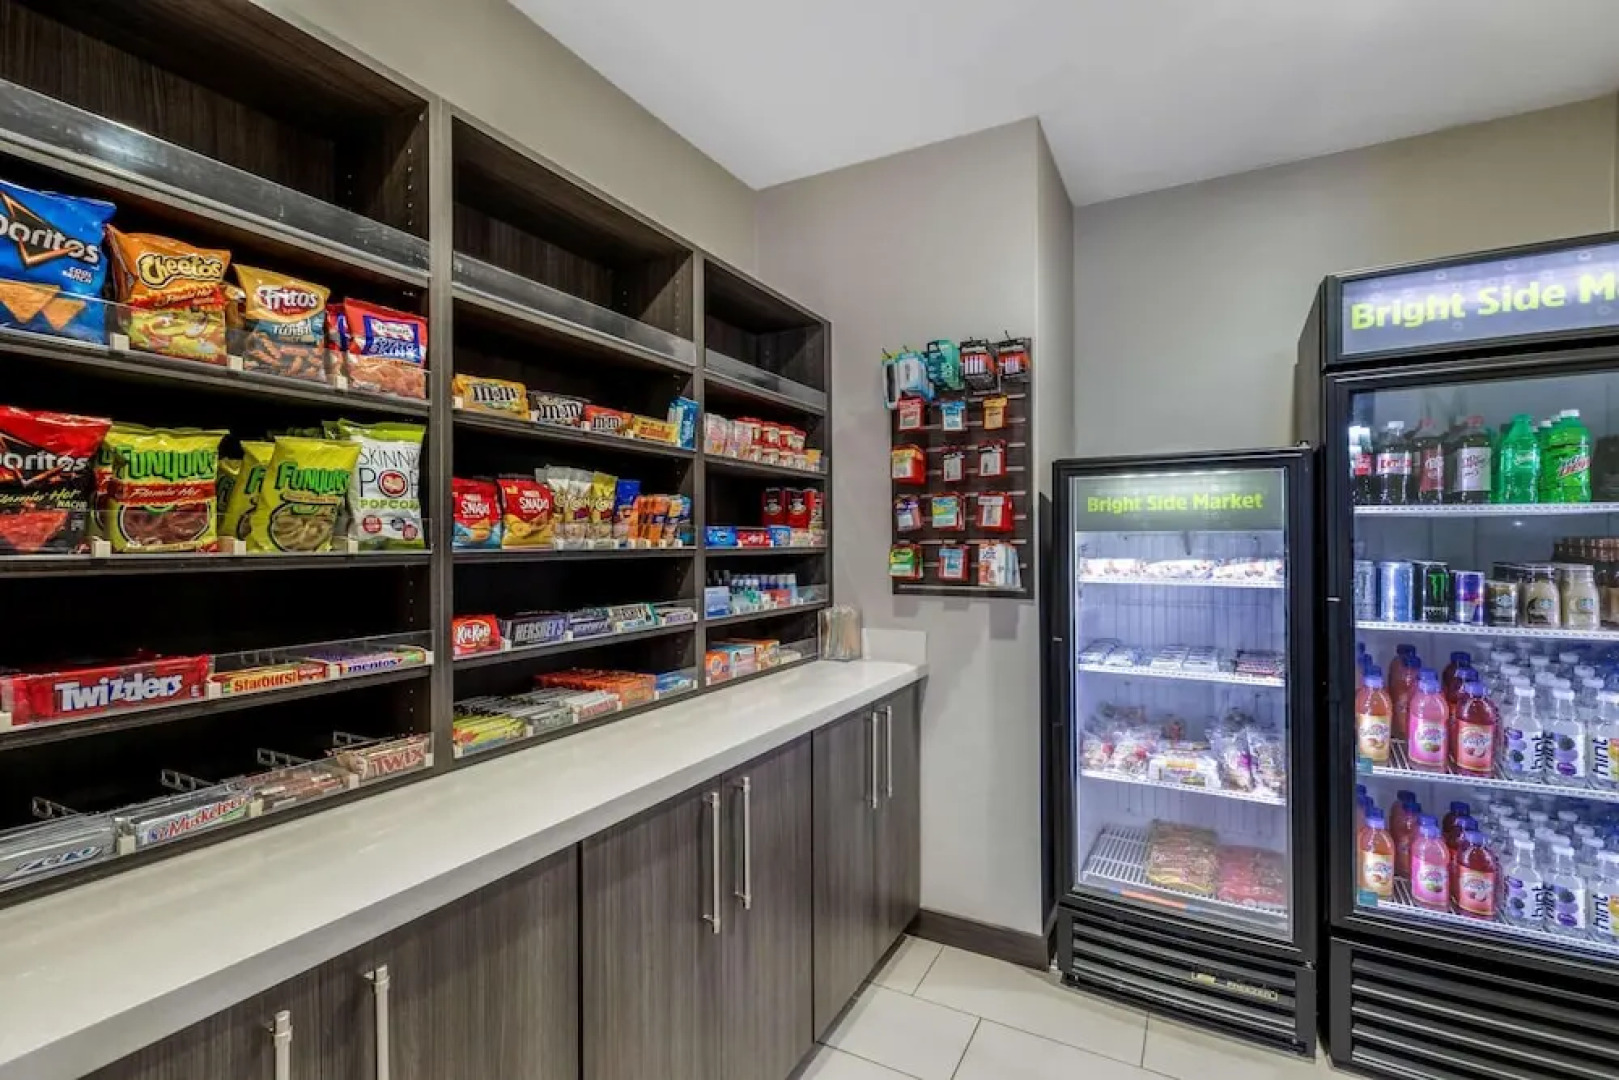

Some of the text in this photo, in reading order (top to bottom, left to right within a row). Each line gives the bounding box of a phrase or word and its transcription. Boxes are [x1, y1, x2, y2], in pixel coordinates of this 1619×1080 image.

[140, 254, 223, 286] Cheetos
[258, 286, 318, 310] Fritos
[1351, 271, 1619, 330] Bright Side M
[0, 450, 90, 472] oritos
[1087, 493, 1264, 514] Bright Side Market
[347, 658, 397, 674] mentos
